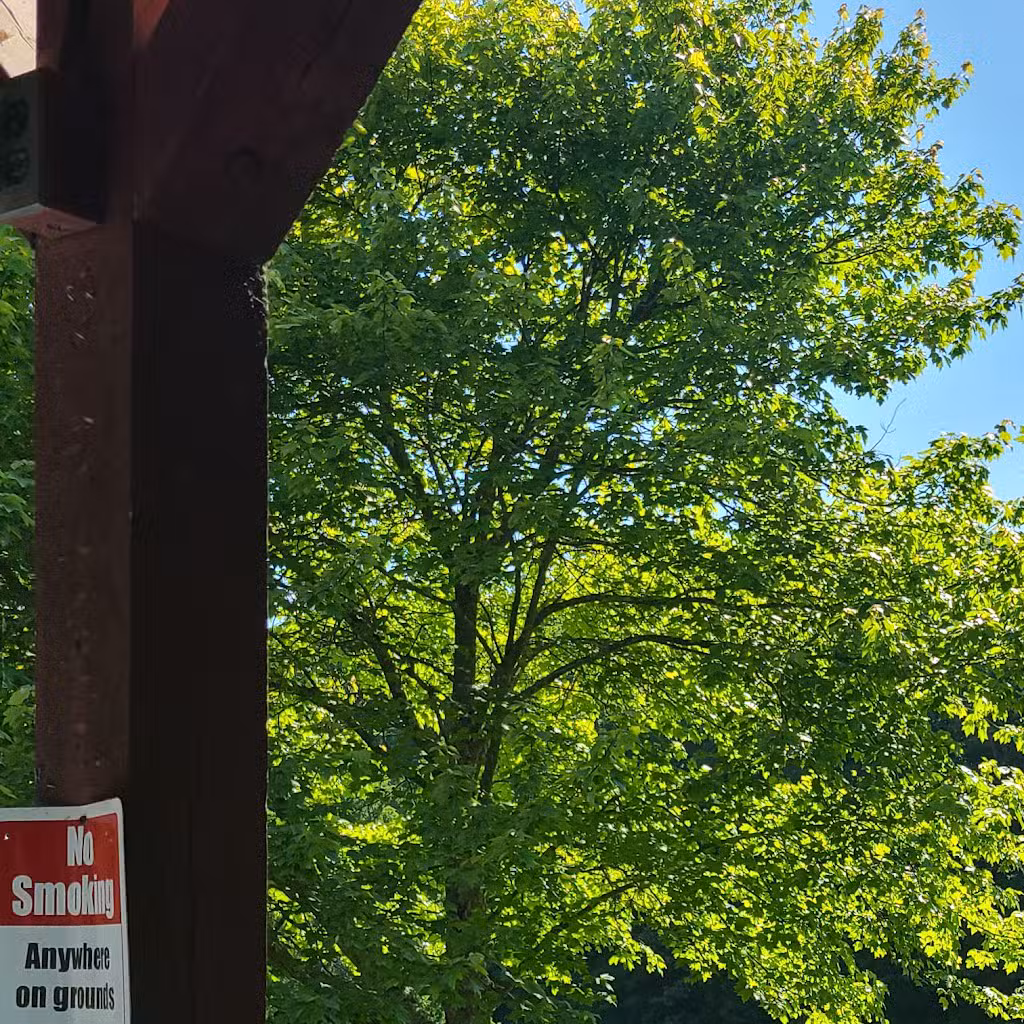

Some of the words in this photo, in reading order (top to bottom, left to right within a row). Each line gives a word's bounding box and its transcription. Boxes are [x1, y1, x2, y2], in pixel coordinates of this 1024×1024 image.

[67, 825, 95, 867] No
[11, 874, 115, 920] Smoking
[24, 942, 110, 973] Anywhere
[15, 985, 47, 1008] on
[53, 982, 115, 1012] grounds
